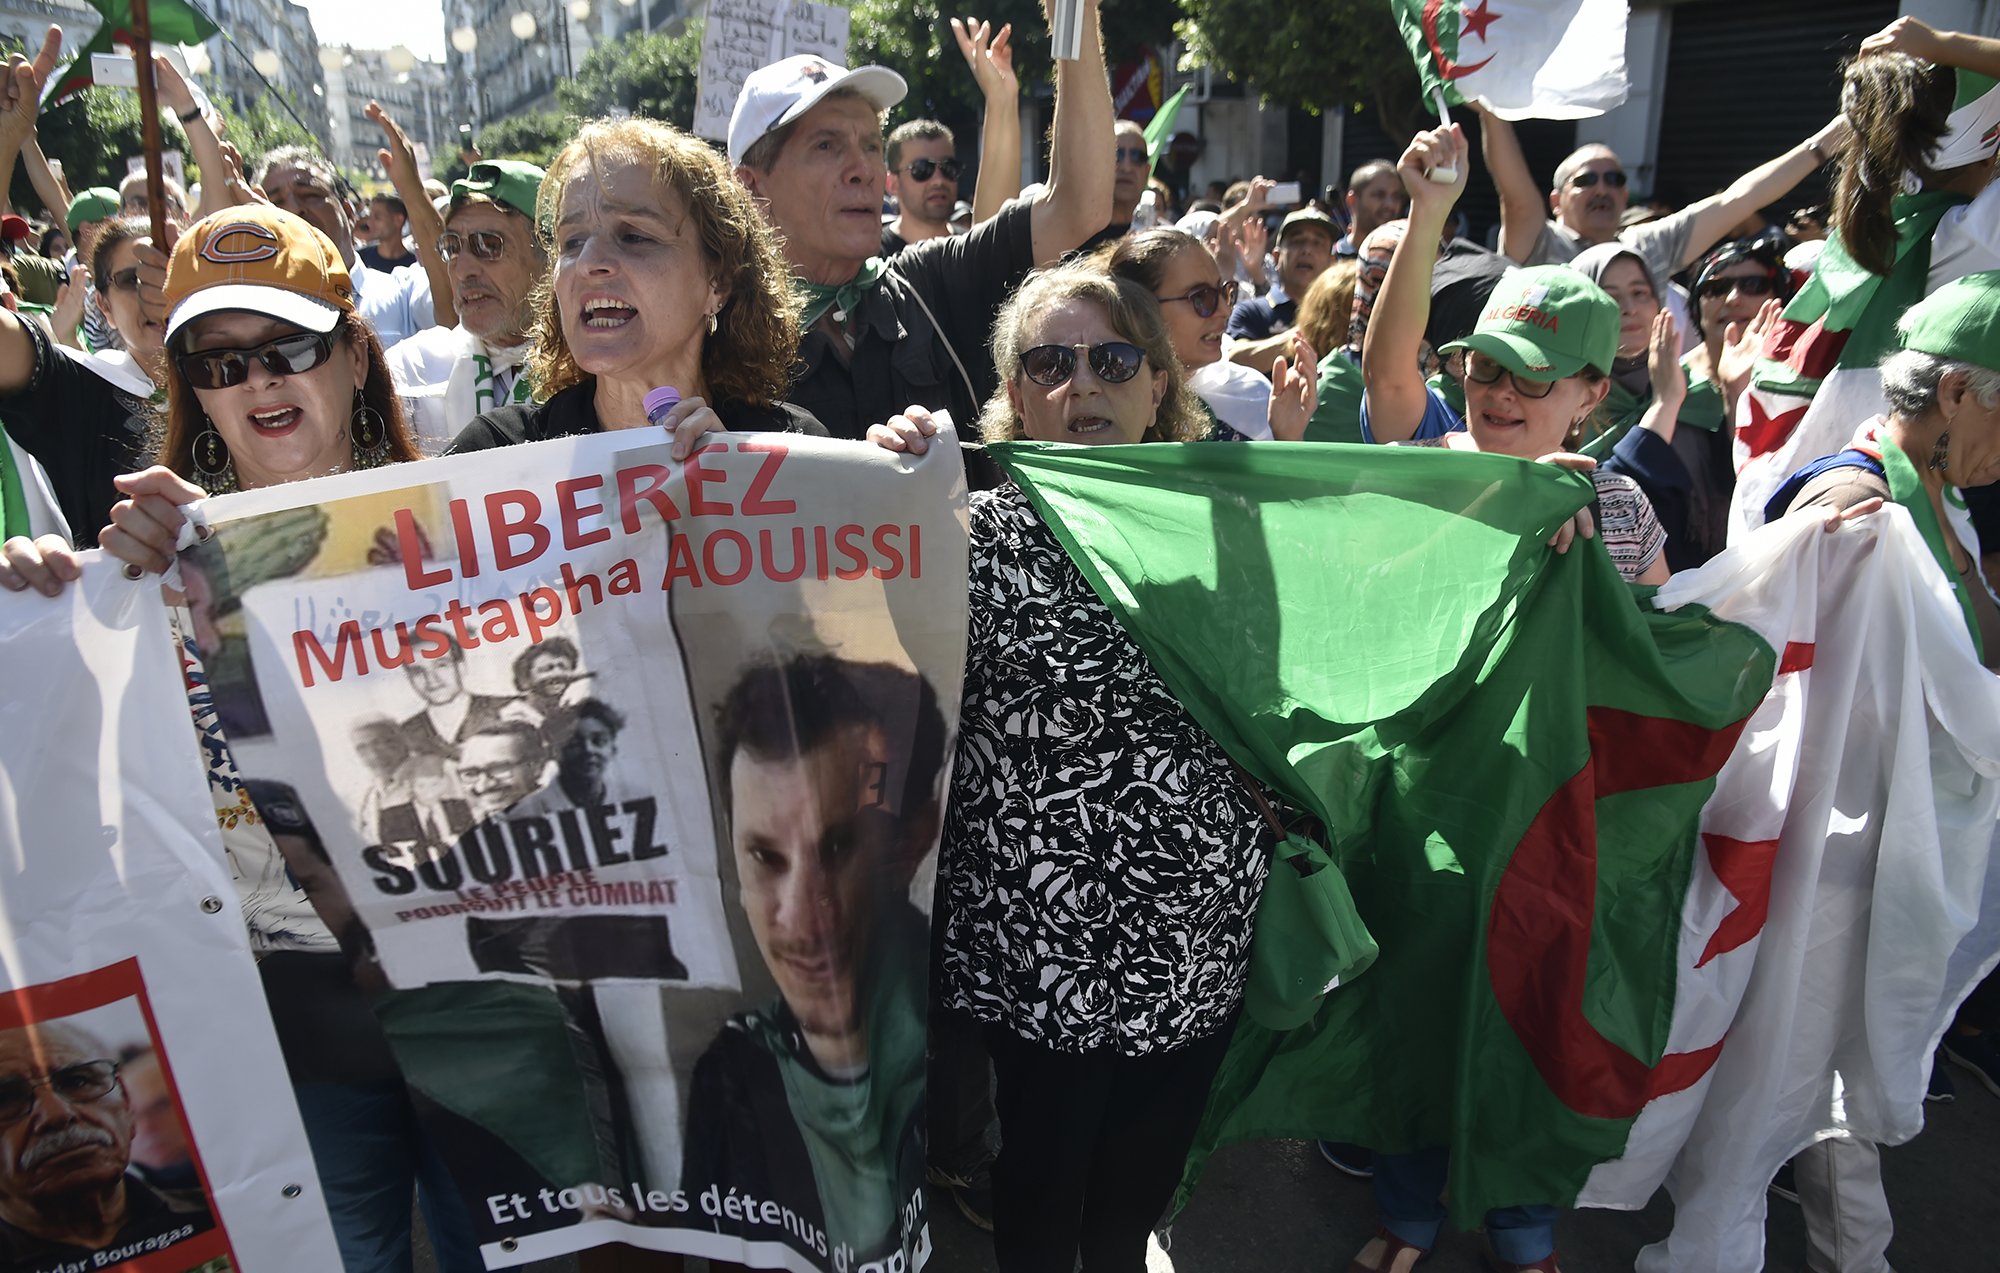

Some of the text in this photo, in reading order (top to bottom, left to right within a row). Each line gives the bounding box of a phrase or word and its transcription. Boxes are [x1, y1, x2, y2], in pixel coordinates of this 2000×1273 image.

[1485, 305, 1560, 335] ALGERIA
[394, 443, 797, 591] LIBEREZ
[292, 558, 641, 688] Mustapha
[662, 523, 921, 591] AOUISSI
[362, 796, 668, 896] SOURIEZ
[395, 879, 678, 922] POURSUIT LE COMBAT
[454, 867, 599, 901] LE PEUPLE
[92, 1223, 195, 1267] Bouragaa
[487, 1193, 532, 1225] Et
[538, 1185, 627, 1214] tous
[631, 1182, 690, 1213] les
[700, 1183, 828, 1258] détenus
